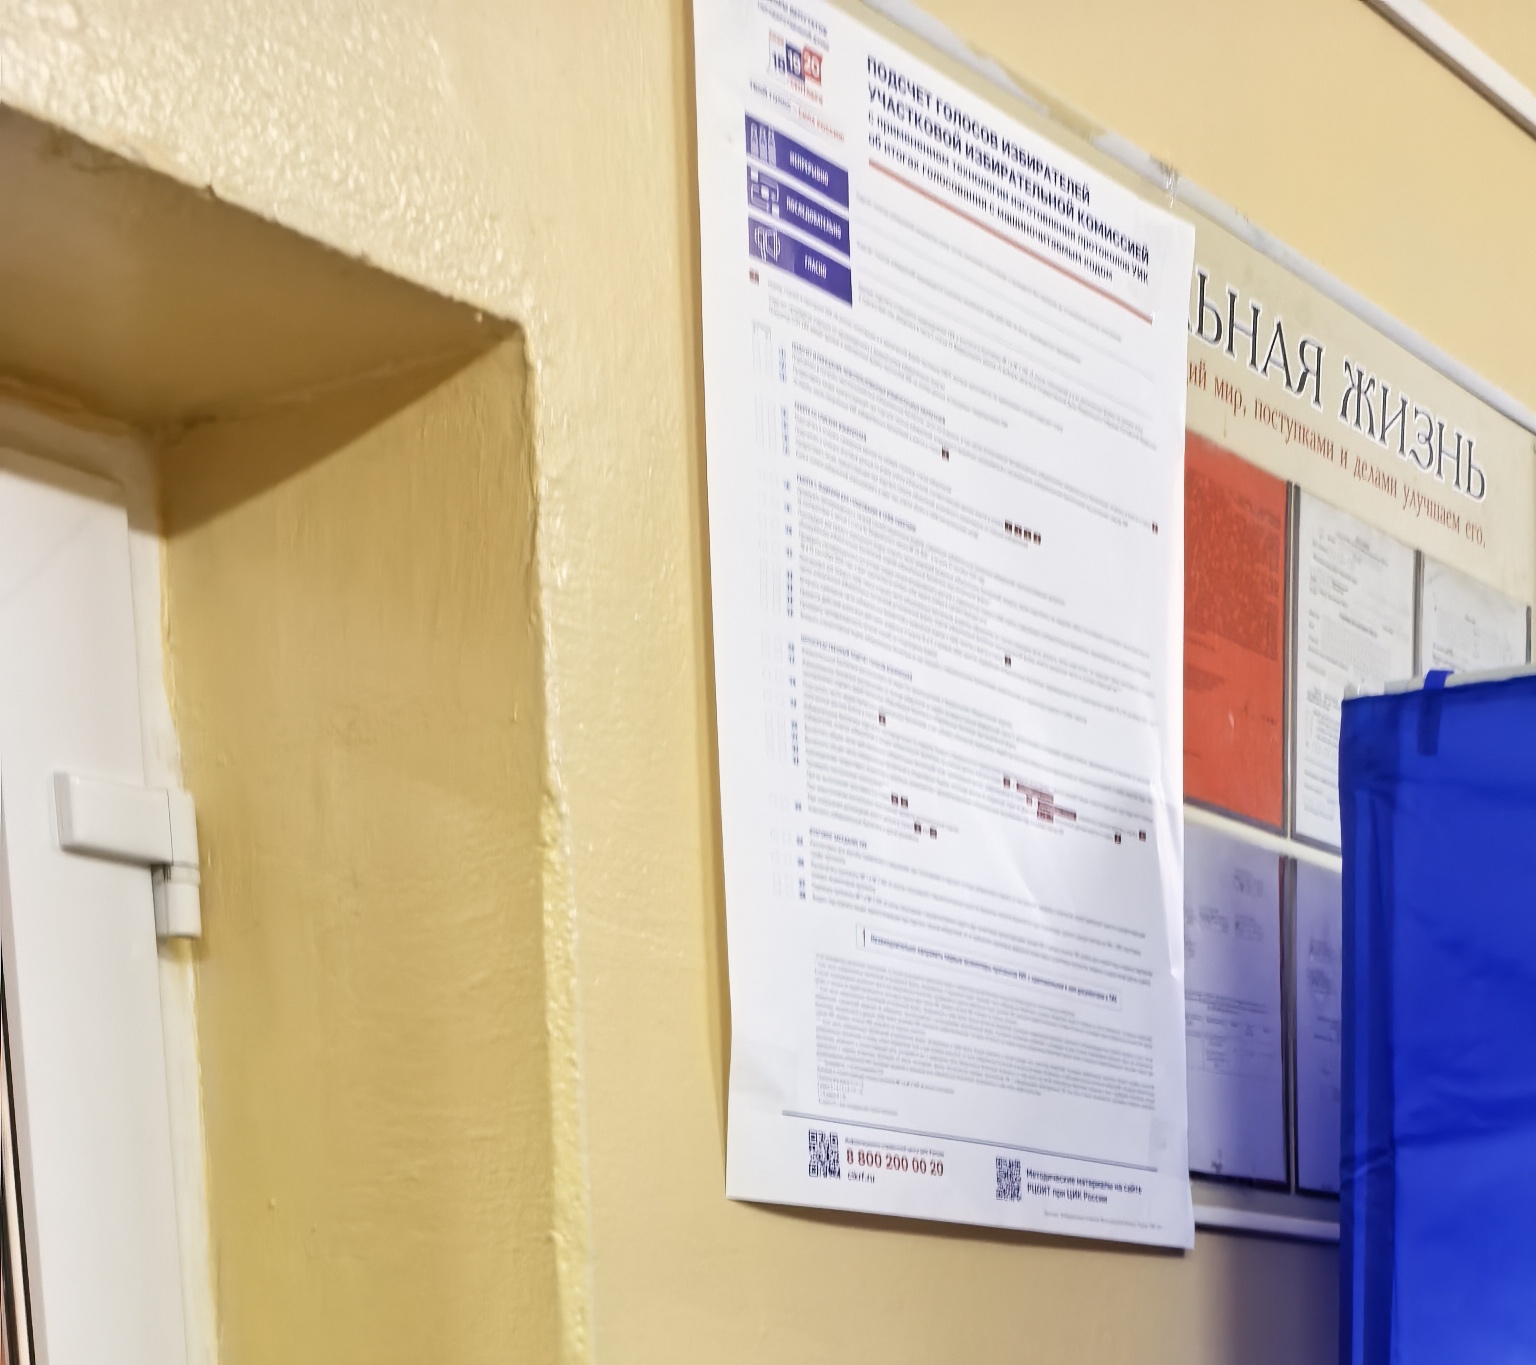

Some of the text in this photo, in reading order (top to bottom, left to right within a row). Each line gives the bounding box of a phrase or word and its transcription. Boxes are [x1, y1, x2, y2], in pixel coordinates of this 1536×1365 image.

[868, 54, 932, 111] ПОДСЧЕТ
[936, 97, 998, 150] ГОЛОСОВ
[1002, 137, 1090, 206] ИЗБИРАТЕЛЕЙ
[869, 81, 961, 154] УЧАСТКОВОЙ
[966, 140, 1074, 222] ИЗБИРАТЕЛЬНОЙ
[1078, 207, 1149, 265] КОМИССИЕЙ
[804, 254, 827, 280] ГЛАСНО
[1187, 358, 1486, 549] ий мир, поступками и делами улучшаем его.
[1188, 271, 1324, 408] ЬНАЯ
[1339, 360, 1486, 500] ЖИЗНЬ
[846, 1148, 943, 1177] 8 800 200 00 20
[1067, 1187, 1082, 1203] ЦИК
[1084, 1191, 1108, 1204] России
